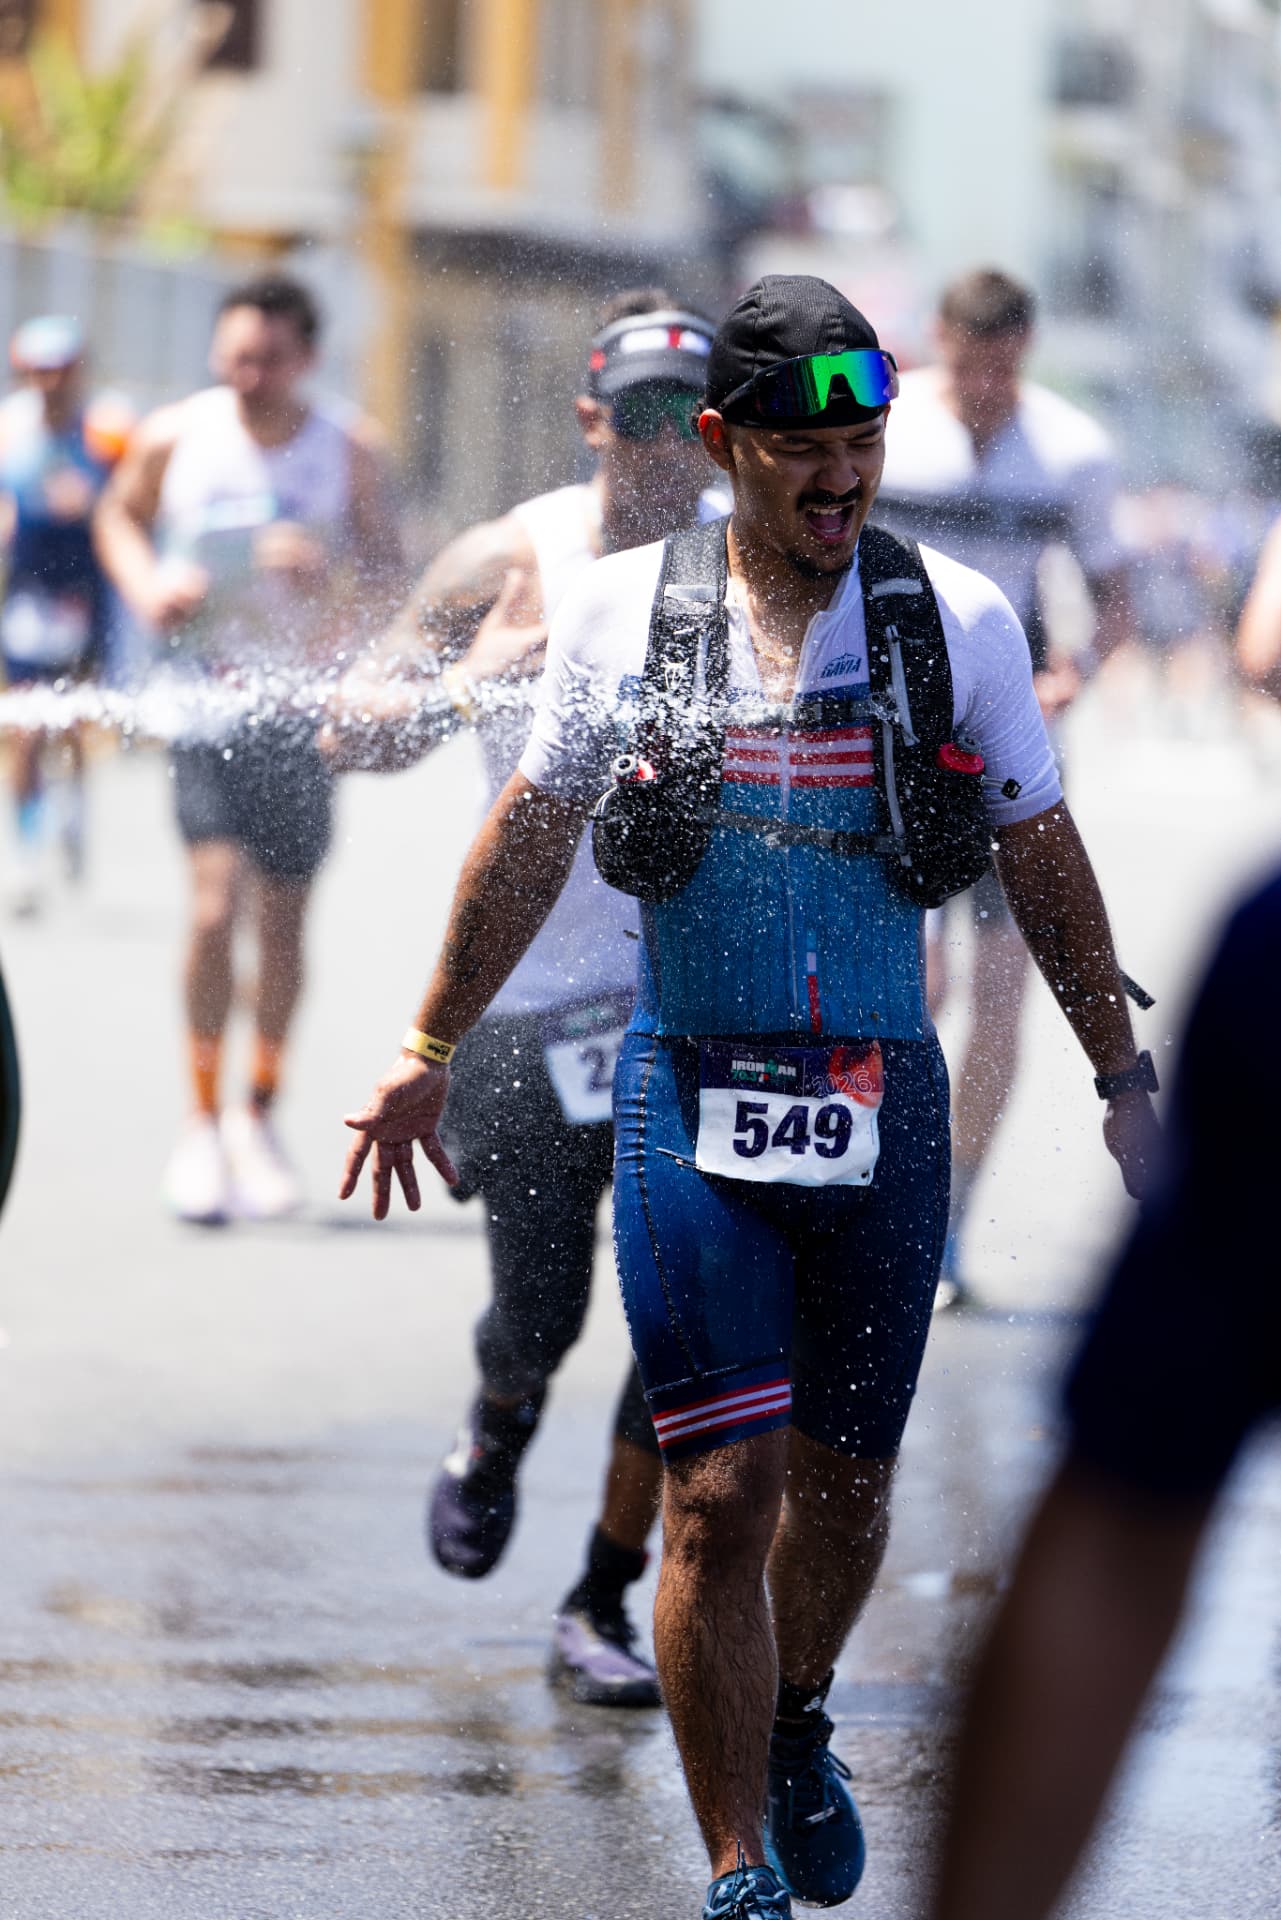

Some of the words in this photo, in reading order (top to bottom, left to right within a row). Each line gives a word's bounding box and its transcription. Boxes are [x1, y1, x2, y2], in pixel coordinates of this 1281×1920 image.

[731, 1059, 797, 1077] IRONMAN
[731, 1069, 757, 1082] 70.3
[811, 1070, 873, 1098] 2026
[732, 1100, 853, 1159] 549
